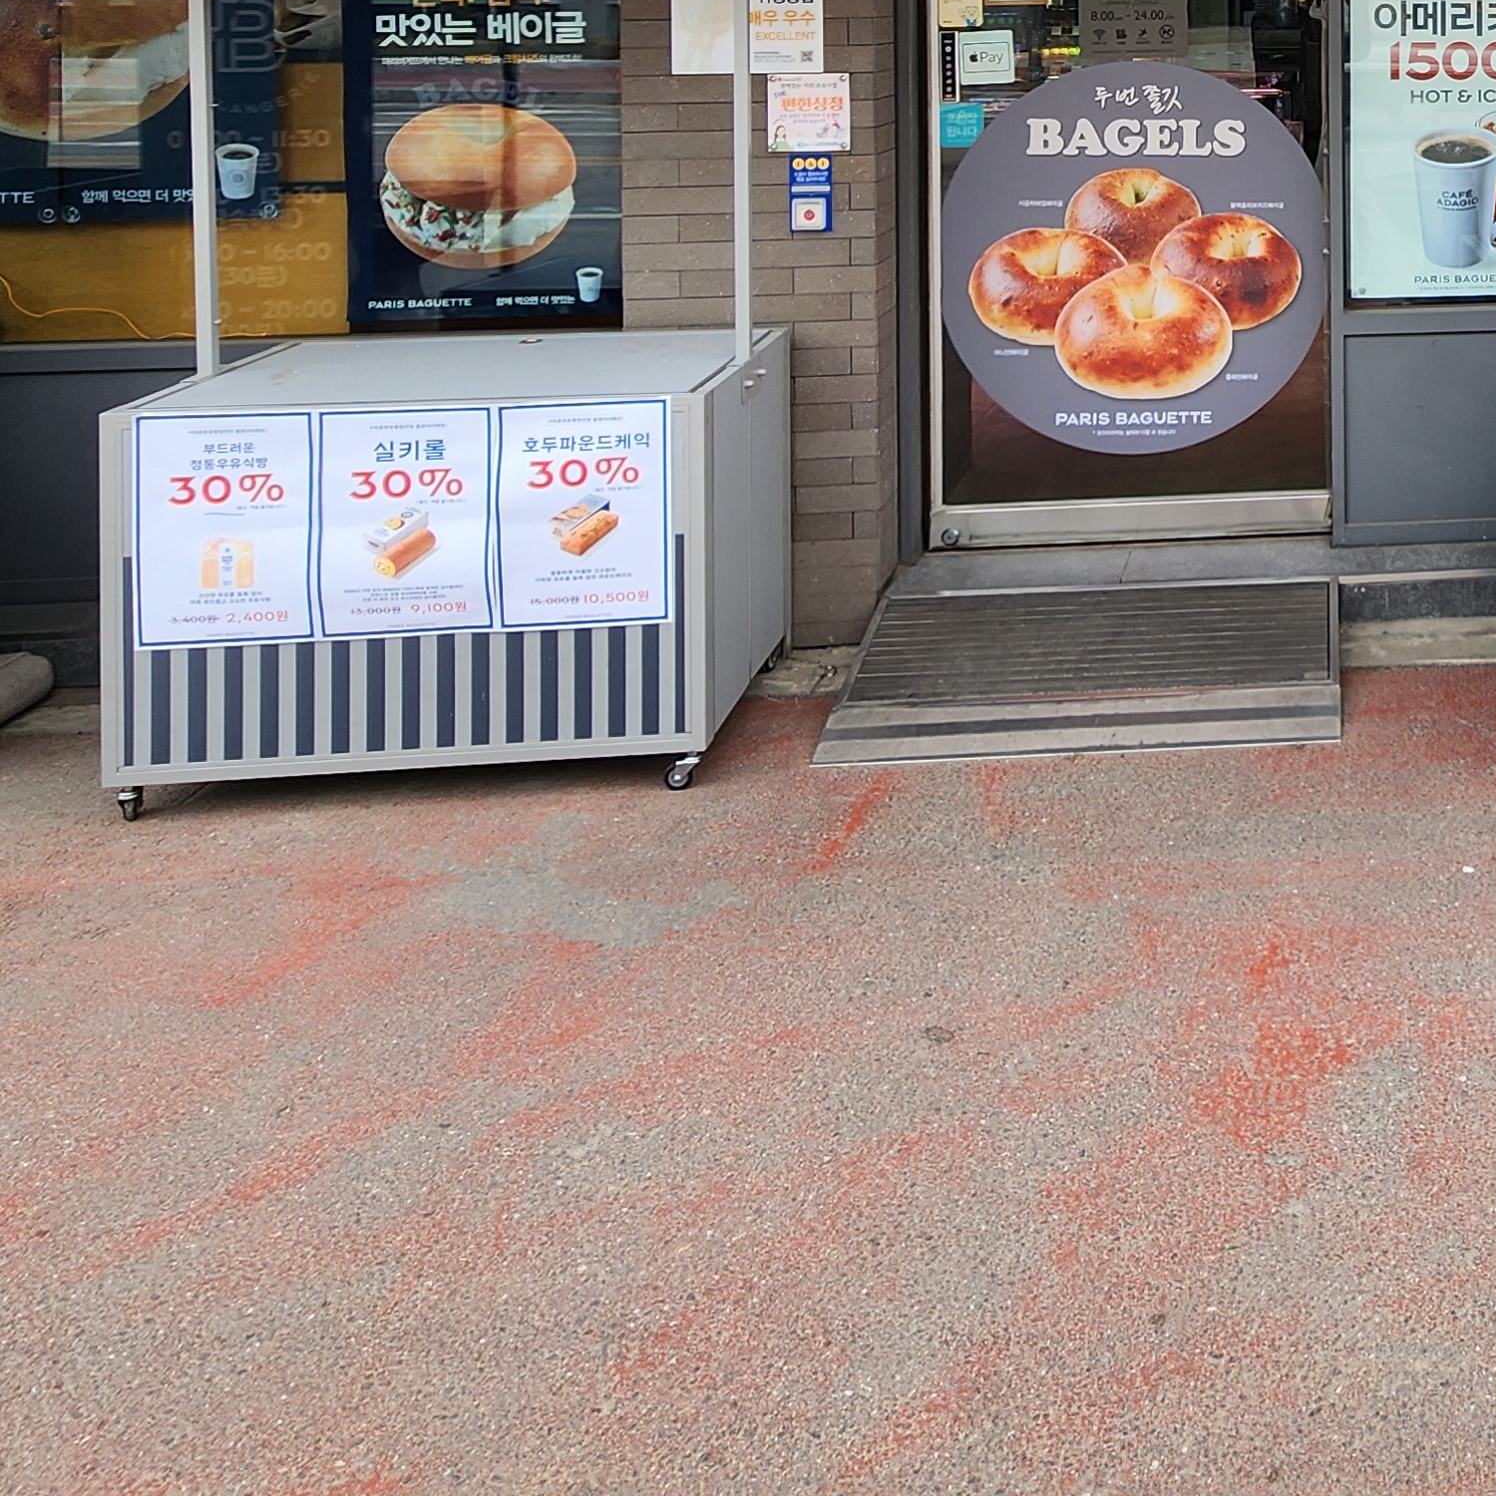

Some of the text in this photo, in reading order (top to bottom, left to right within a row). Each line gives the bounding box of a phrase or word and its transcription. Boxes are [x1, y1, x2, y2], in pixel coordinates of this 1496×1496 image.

[783, 10, 816, 25] 우수
[375, 11, 587, 47] 맛있는 베이글
[756, 31, 816, 41] EXCELLENT
[980, 50, 1004, 64] Pay
[1410, 90, 1453, 104] HOT
[1457, 90, 1472, 103] &
[1026, 118, 1247, 157] BAGELS
[81, 189, 109, 204] 함께
[112, 189, 151, 203] 먹으면
[155, 189, 169, 203] 더
[1441, 189, 1473, 199] CAFÉ
[1437, 196, 1479, 208] ADAGIO
[1414, 275, 1450, 284] PARIS
[368, 297, 473, 310] PARIS BAGUETTE
[1055, 410, 1213, 426] PARIS BAGUETTE
[203, 442, 255, 454] 부드러운
[522, 432, 651, 454] 호두파운드케익
[373, 439, 447, 463] 실키롤
[526, 456, 639, 490] 30%
[168, 473, 284, 506] 30%
[349, 468, 463, 501] 30%
[583, 590, 650, 605] 10,500원
[411, 601, 467, 616] 9,100원
[226, 610, 289, 625] 2,400원
